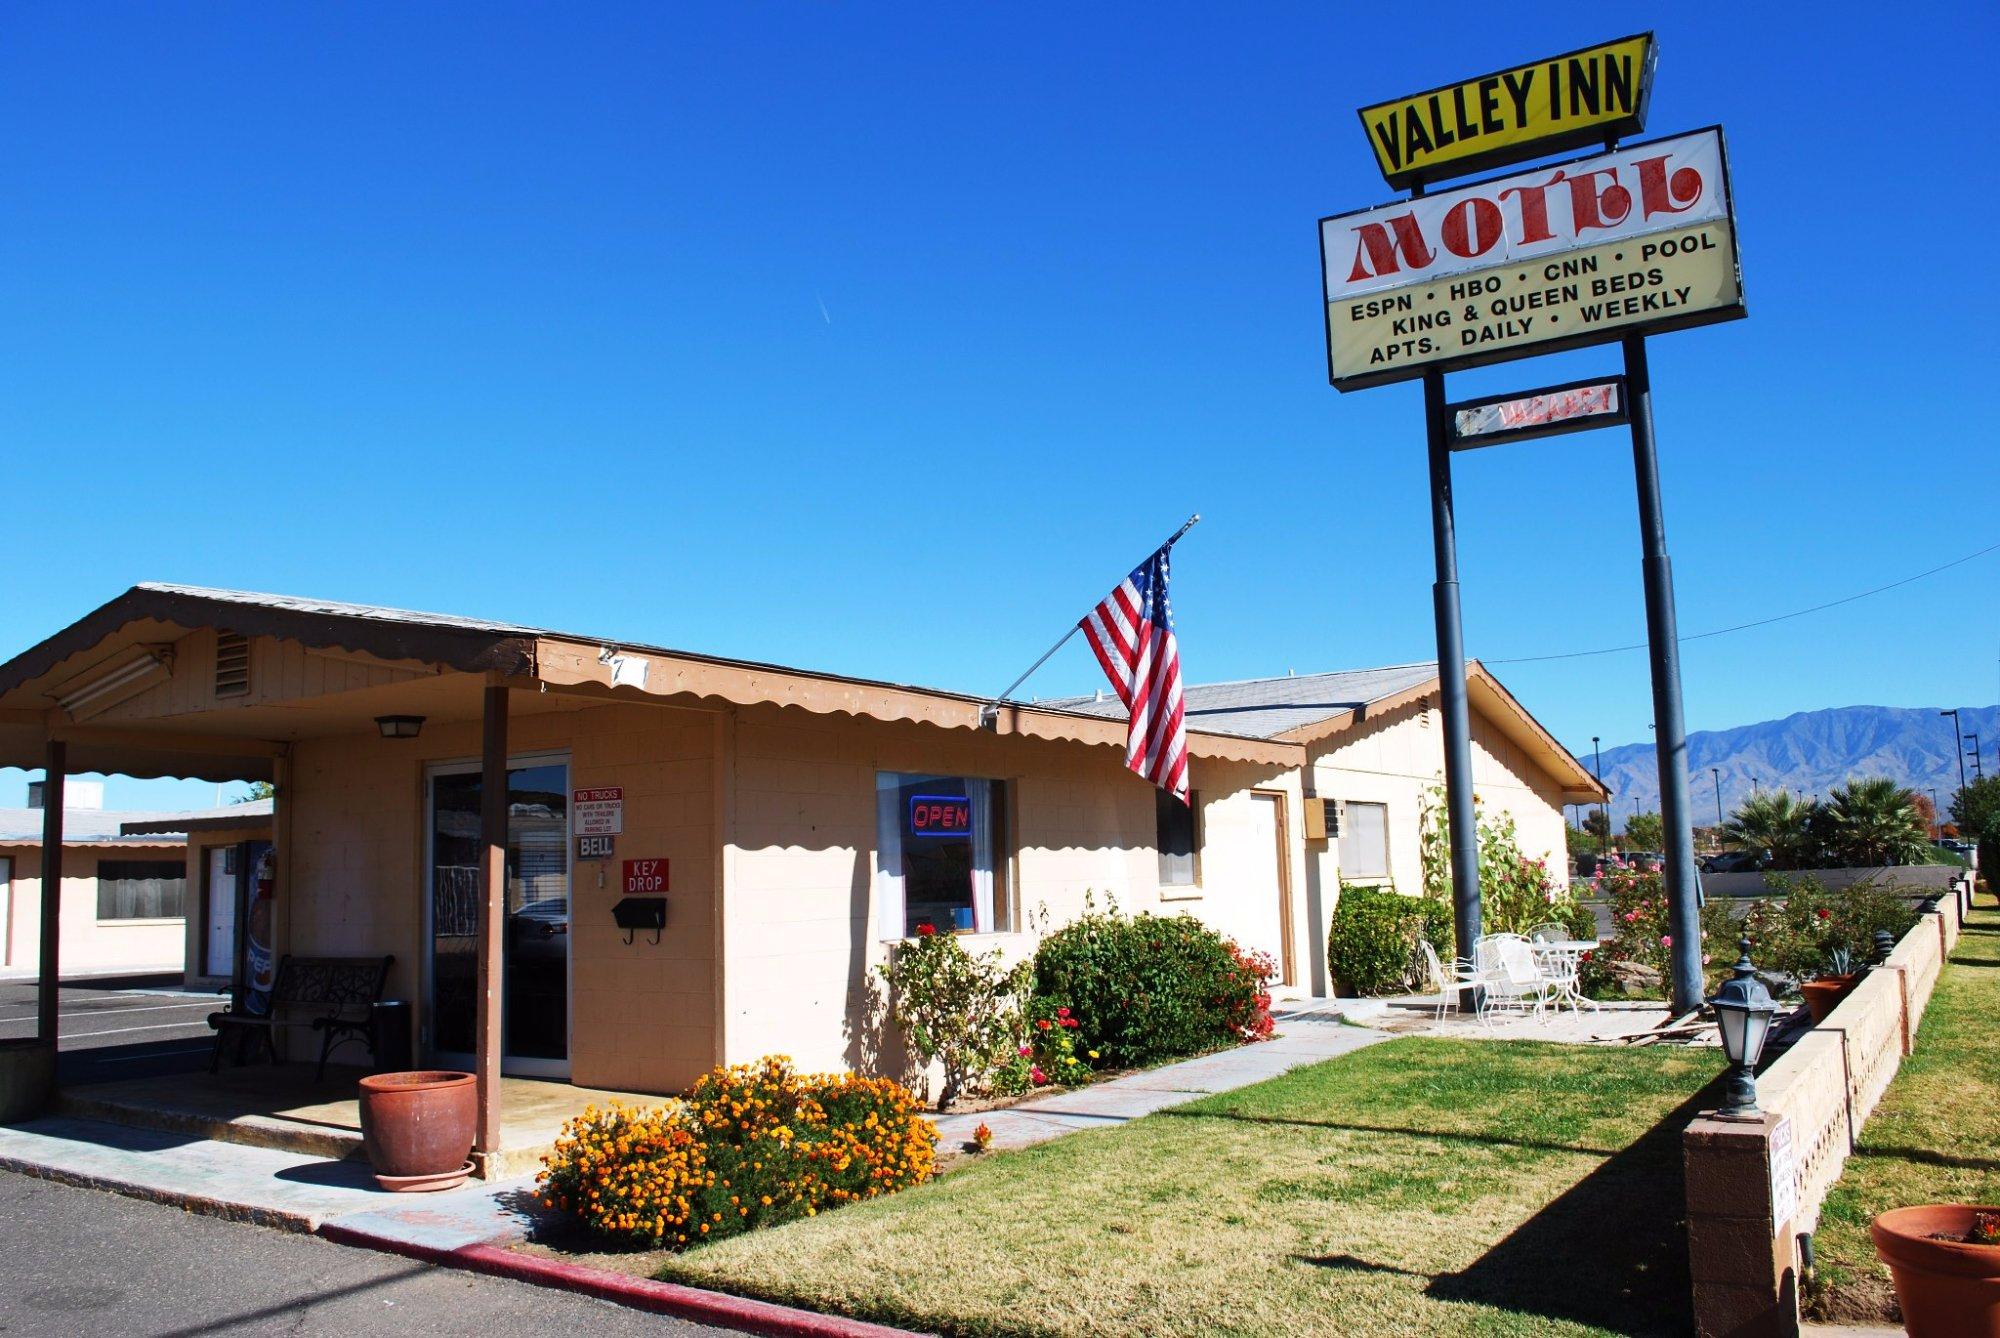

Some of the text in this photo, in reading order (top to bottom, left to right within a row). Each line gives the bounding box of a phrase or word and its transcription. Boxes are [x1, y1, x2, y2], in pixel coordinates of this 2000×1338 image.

[1375, 54, 1632, 171] VALLEY INN
[1346, 154, 1703, 283] MOTEL
[1351, 232, 1717, 321] ESPN HBO CNN POOL
[1392, 268, 1664, 337] KING & QUEEN BEDS
[1369, 286, 1692, 365] APTS. DAILY WEEKLY
[577, 790, 618, 801] NO TRUCKS
[914, 805, 968, 827] OPEN
[580, 838, 612, 856] BELL
[633, 860, 658, 876] KEY
[629, 876, 662, 891] DROP
